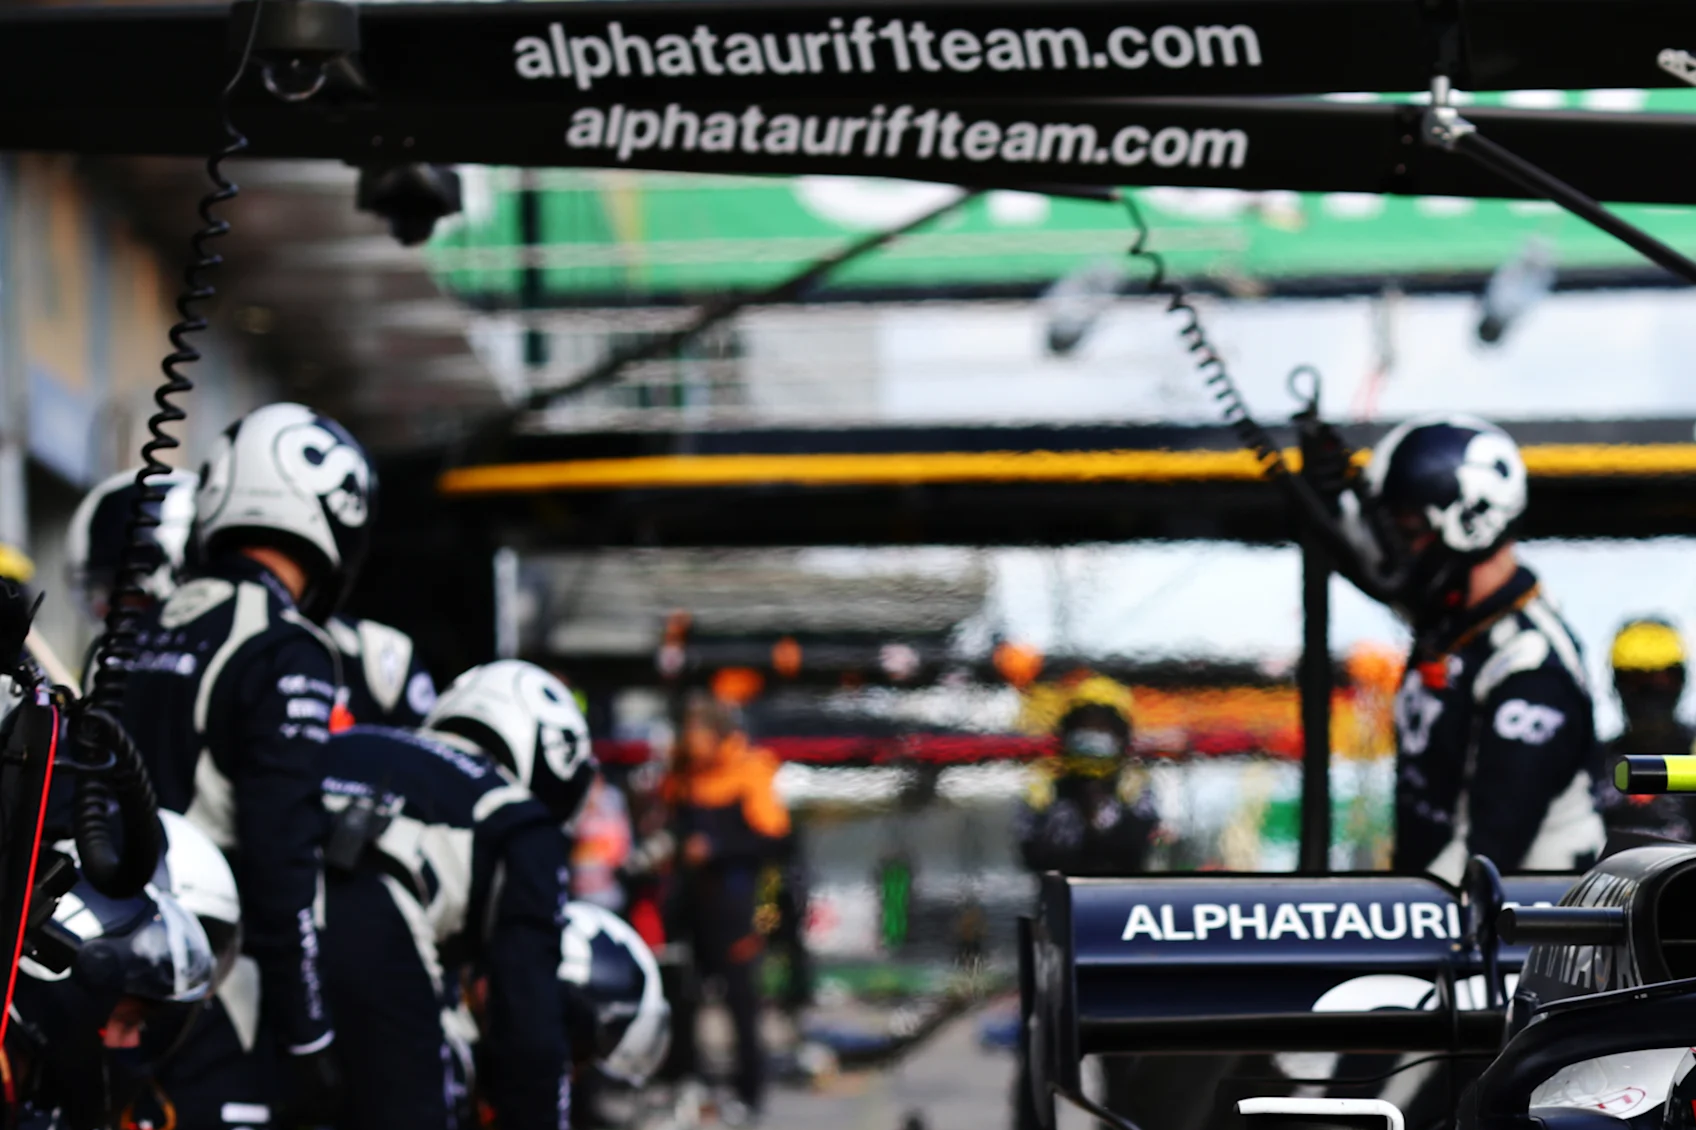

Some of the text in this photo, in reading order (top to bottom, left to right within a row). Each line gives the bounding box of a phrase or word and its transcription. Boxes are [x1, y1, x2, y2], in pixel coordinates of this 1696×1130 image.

[514, 18, 1262, 90] alphataurif1team.com
[566, 104, 1249, 168] alphataurif1team.com
[1122, 902, 1461, 942] ALPHATAURI
